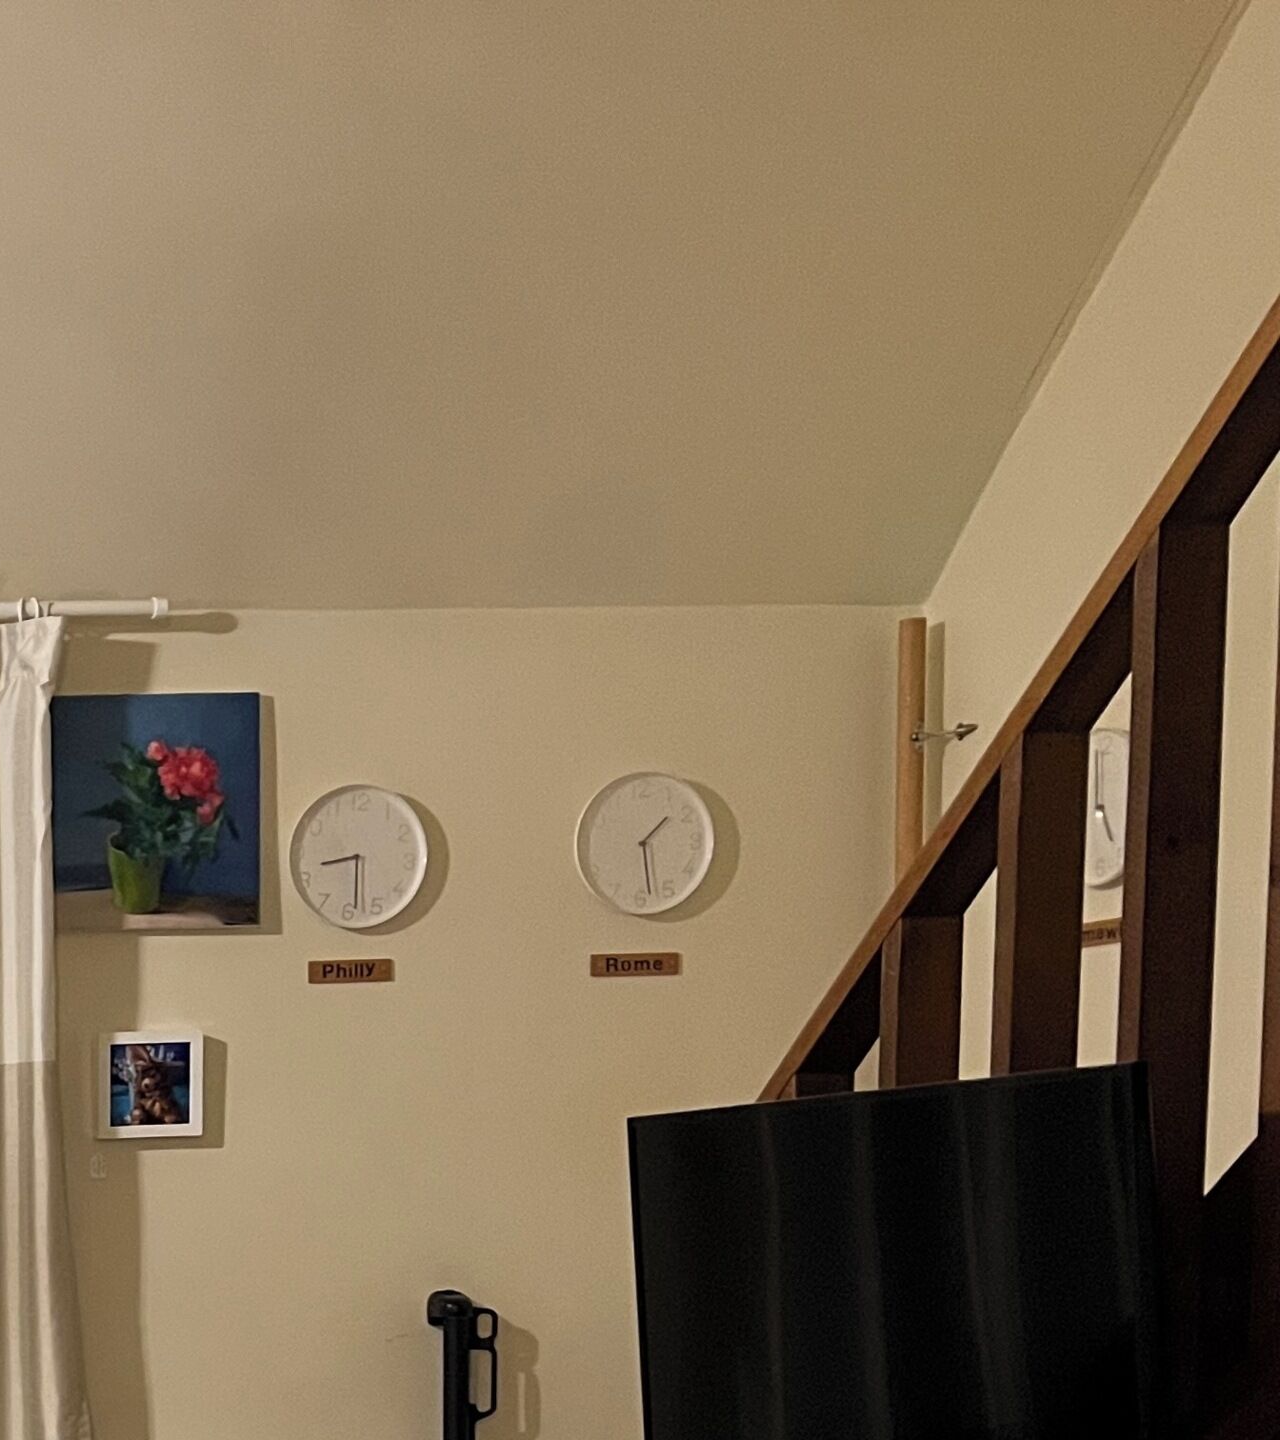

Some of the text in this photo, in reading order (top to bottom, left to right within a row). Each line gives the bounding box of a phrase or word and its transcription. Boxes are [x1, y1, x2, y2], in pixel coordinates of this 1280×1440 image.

[352, 792, 370, 812] 12
[385, 802, 390, 821] 1
[680, 804, 694, 823] 2
[397, 823, 412, 843] 2
[689, 832, 702, 851] 3
[402, 852, 416, 871] 3
[392, 878, 405, 898] 4
[662, 879, 676, 898] 5
[318, 892, 332, 909] 7
[369, 896, 384, 916] 5
[634, 889, 647, 909] 6
[341, 902, 355, 921] 6
[322, 962, 377, 979] Philly
[605, 957, 663, 973] Rome
